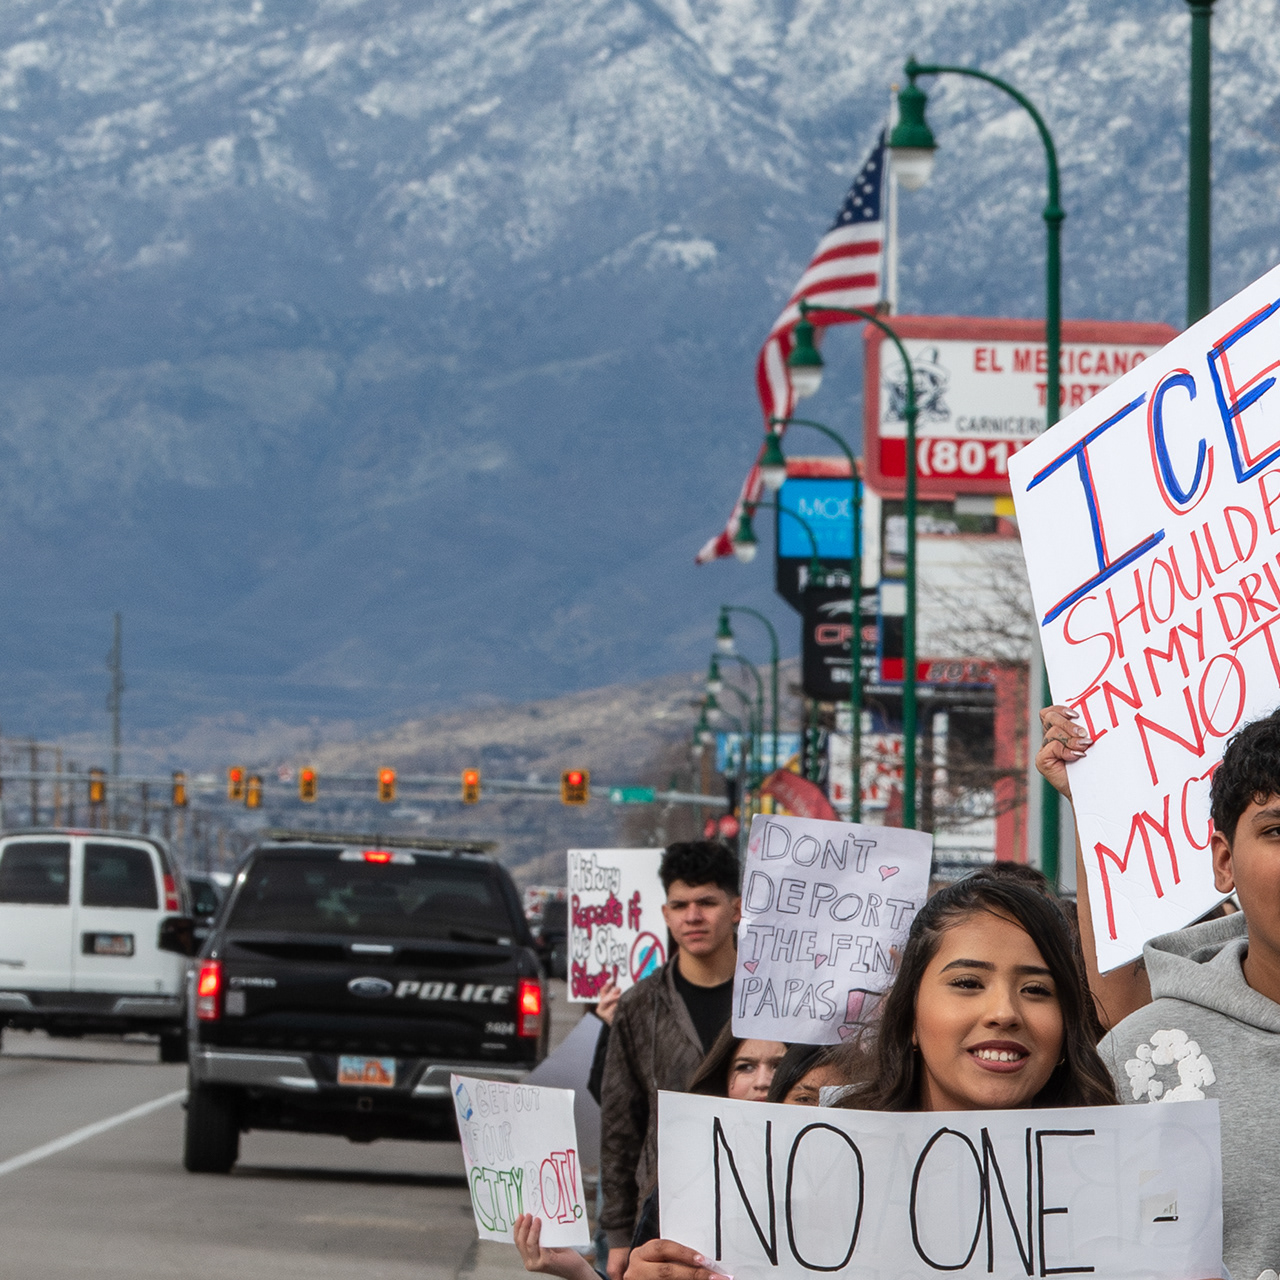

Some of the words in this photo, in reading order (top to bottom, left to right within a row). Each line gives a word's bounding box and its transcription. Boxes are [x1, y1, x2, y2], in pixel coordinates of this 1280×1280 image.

[973, 347, 1003, 373] EL
[1063, 505, 1258, 702] SHOULD
[1067, 662, 1142, 742] IN
[1143, 607, 1205, 697] MY
[761, 821, 878, 874] DON'T
[1094, 794, 1181, 940] MY
[570, 853, 621, 895] History
[745, 871, 915, 930] DEPORT
[571, 929, 591, 961] We
[595, 927, 628, 977] Stay
[747, 925, 817, 963] THE
[395, 980, 513, 1004] POLICE
[739, 977, 837, 1021] PAPAS
[475, 1081, 510, 1118] GET
[513, 1086, 541, 1112] OUT
[483, 1121, 514, 1165] OUR
[713, 1116, 864, 1272] NO
[909, 1126, 1096, 1278] ONE
